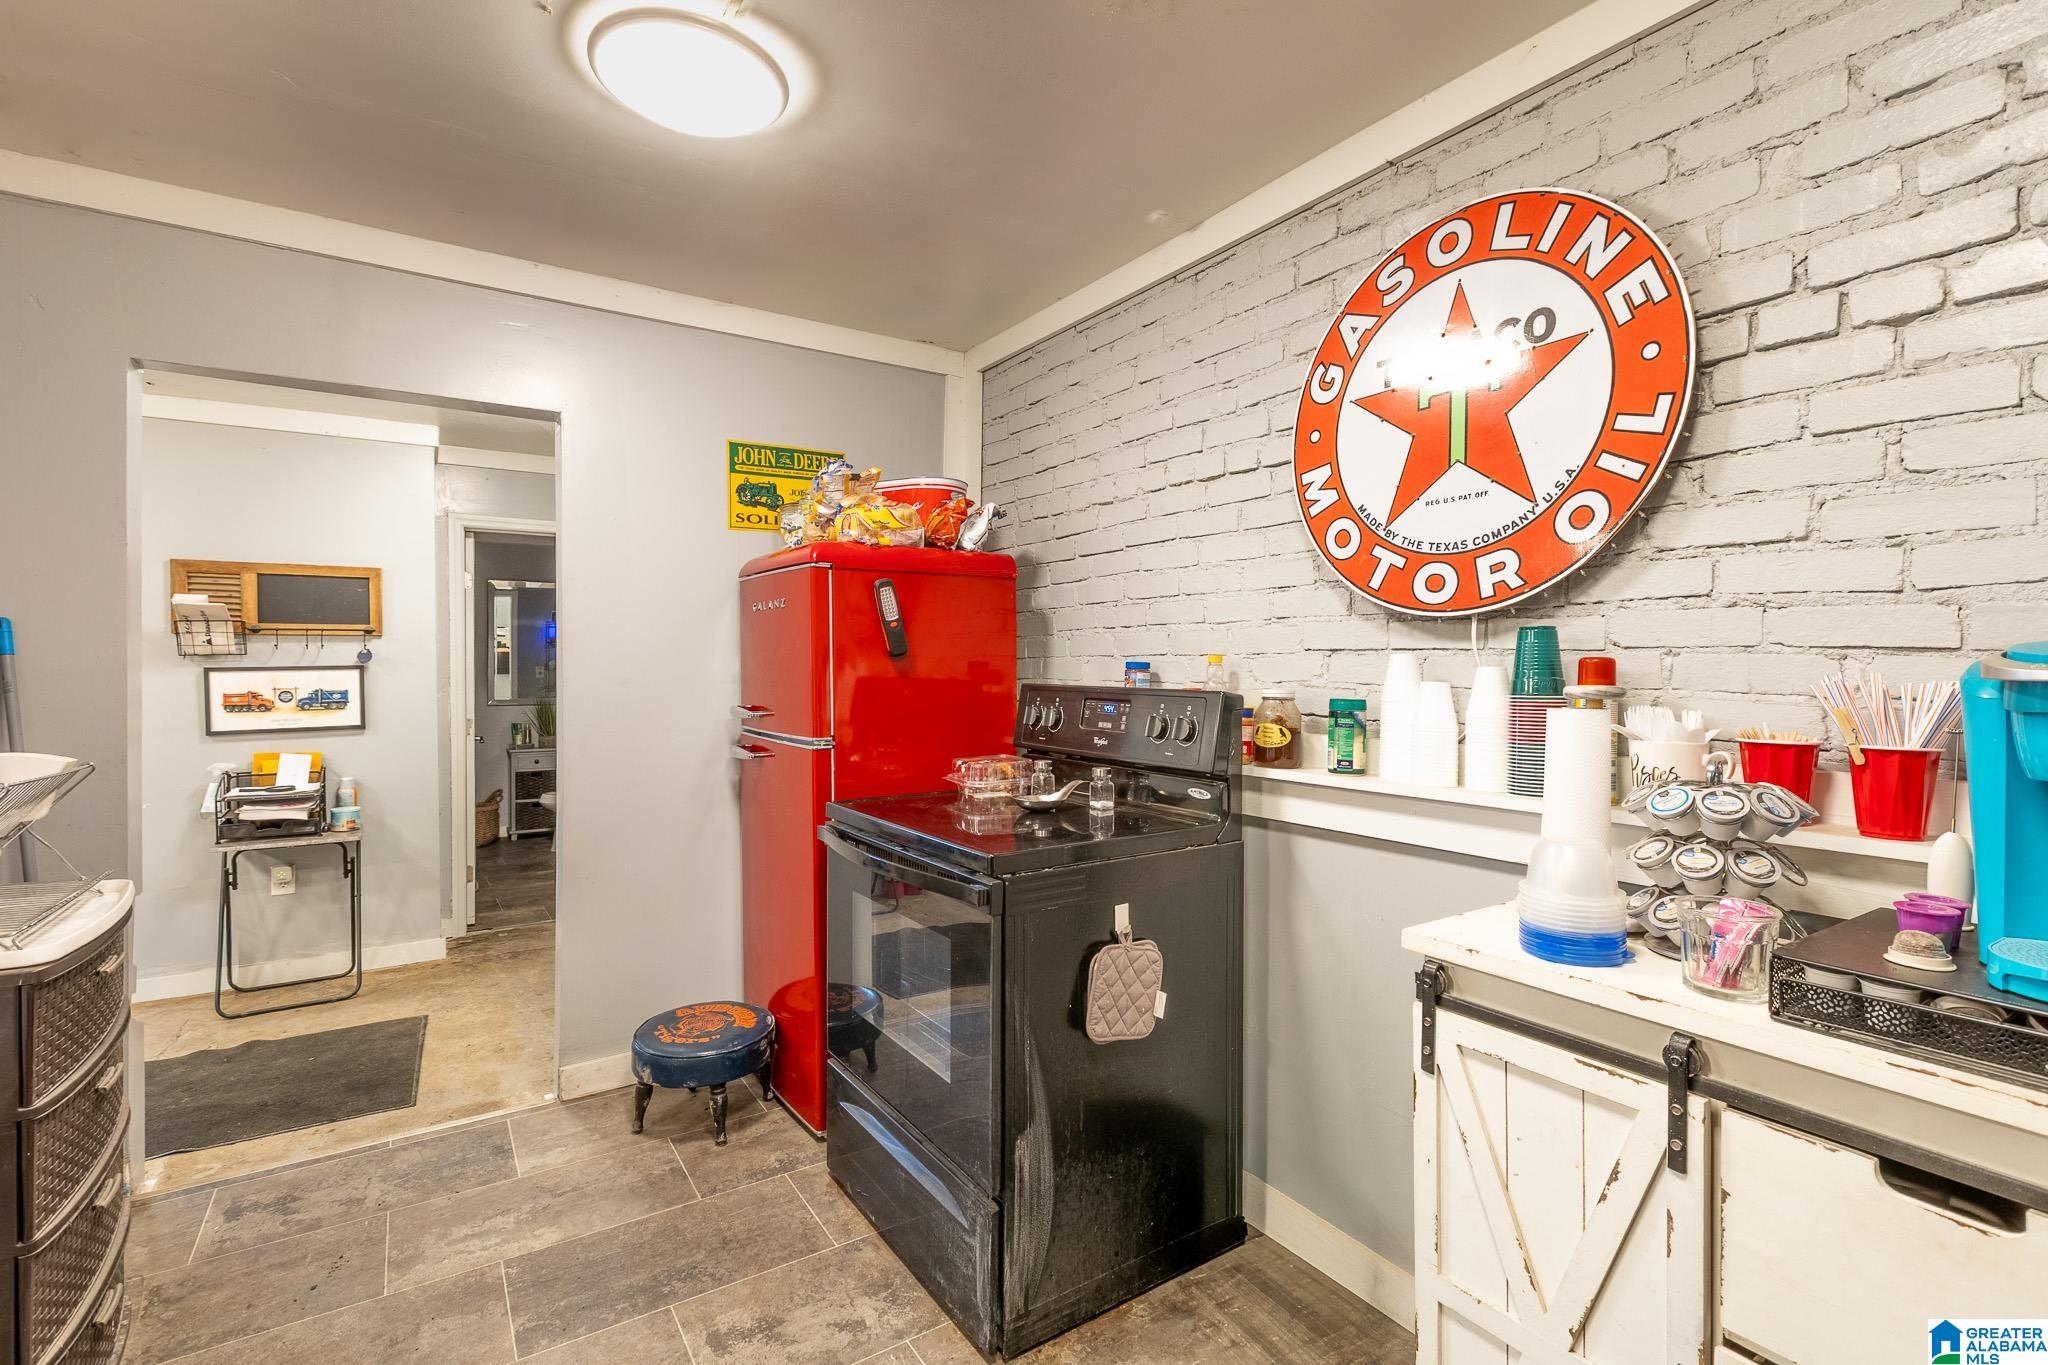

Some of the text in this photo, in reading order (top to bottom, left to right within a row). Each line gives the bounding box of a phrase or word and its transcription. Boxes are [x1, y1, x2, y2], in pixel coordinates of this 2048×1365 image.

[1309, 200, 1671, 405] GASOLINE
[734, 446, 776, 467] JOHN
[1300, 392, 1677, 605] MOTOR OIL
[1357, 464, 1580, 552] MADE BY THE TEXAS COMPANY U.S.A.
